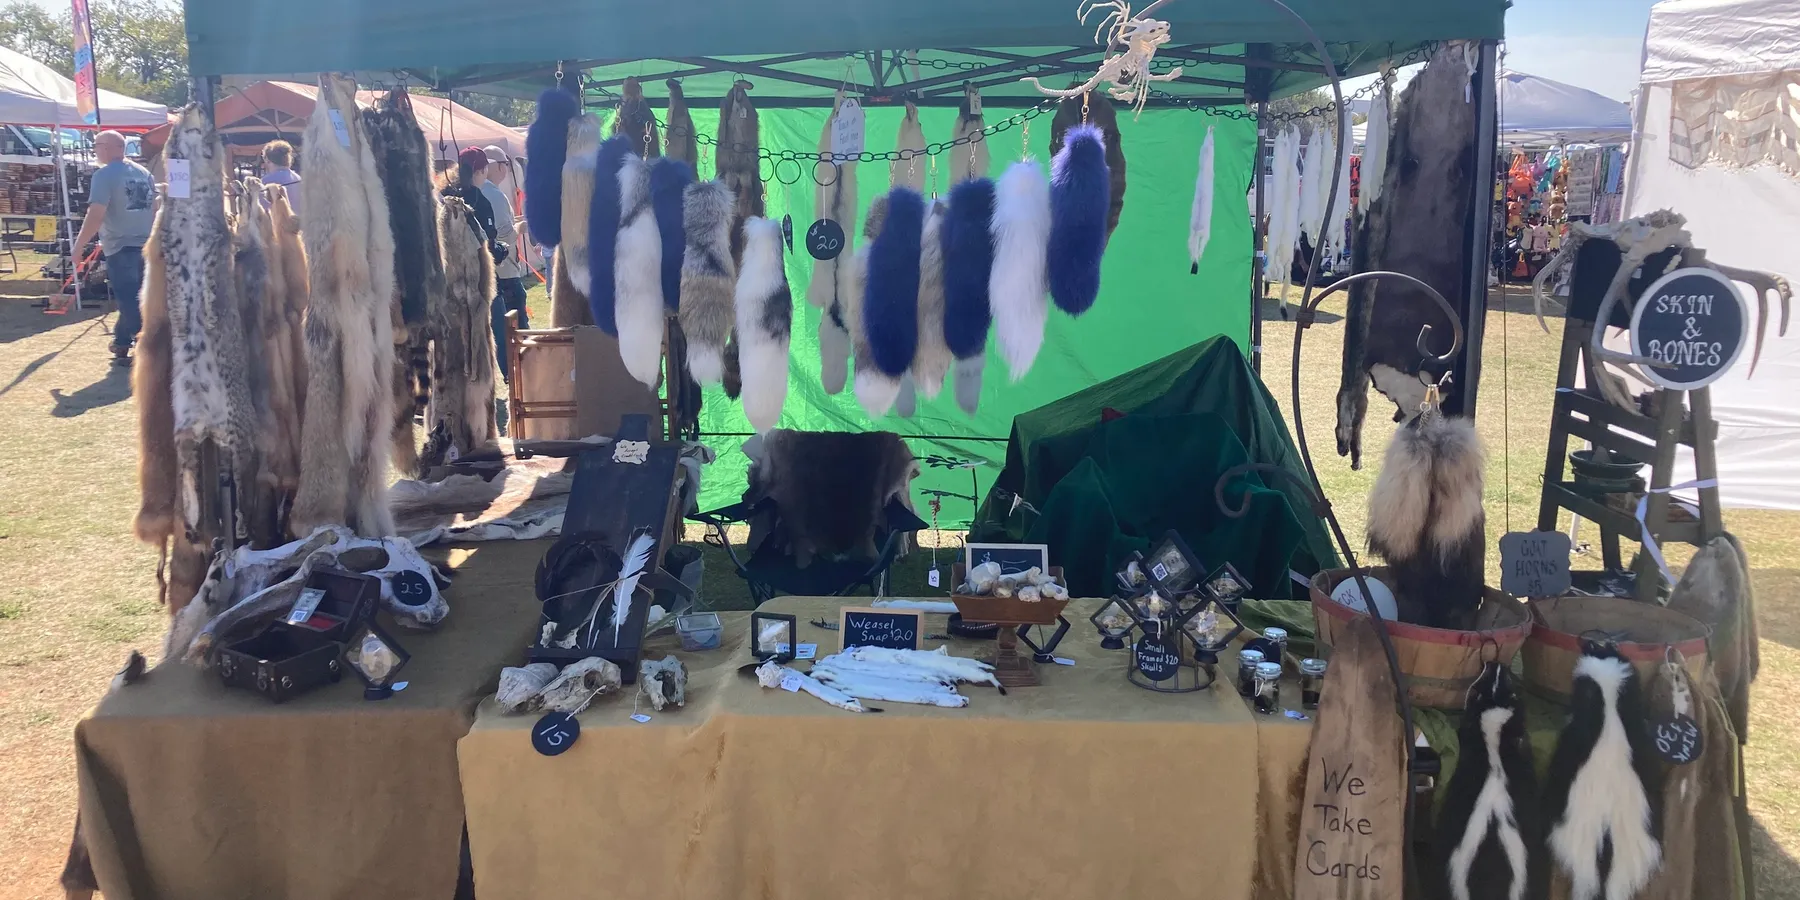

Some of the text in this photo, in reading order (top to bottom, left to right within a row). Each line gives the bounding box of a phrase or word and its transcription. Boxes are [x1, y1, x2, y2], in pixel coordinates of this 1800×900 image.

[1656, 294, 1715, 315] SKIN
[1682, 316, 1702, 339] &
[1648, 339, 1722, 366] BONES
[1515, 559, 1558, 578] HORNS
[401, 582, 423, 595] 25
[849, 615, 895, 630] Weasel
[861, 628, 914, 643] Snap $20
[1144, 639, 1165, 654] Small
[1138, 651, 1179, 665] Framed $20
[1140, 662, 1163, 673] Skulls
[540, 723, 570, 746] 15
[1672, 721, 1698, 762] MINK
[1321, 757, 1366, 796] We
[1313, 804, 1373, 835] Take
[1306, 840, 1380, 880] Cards
